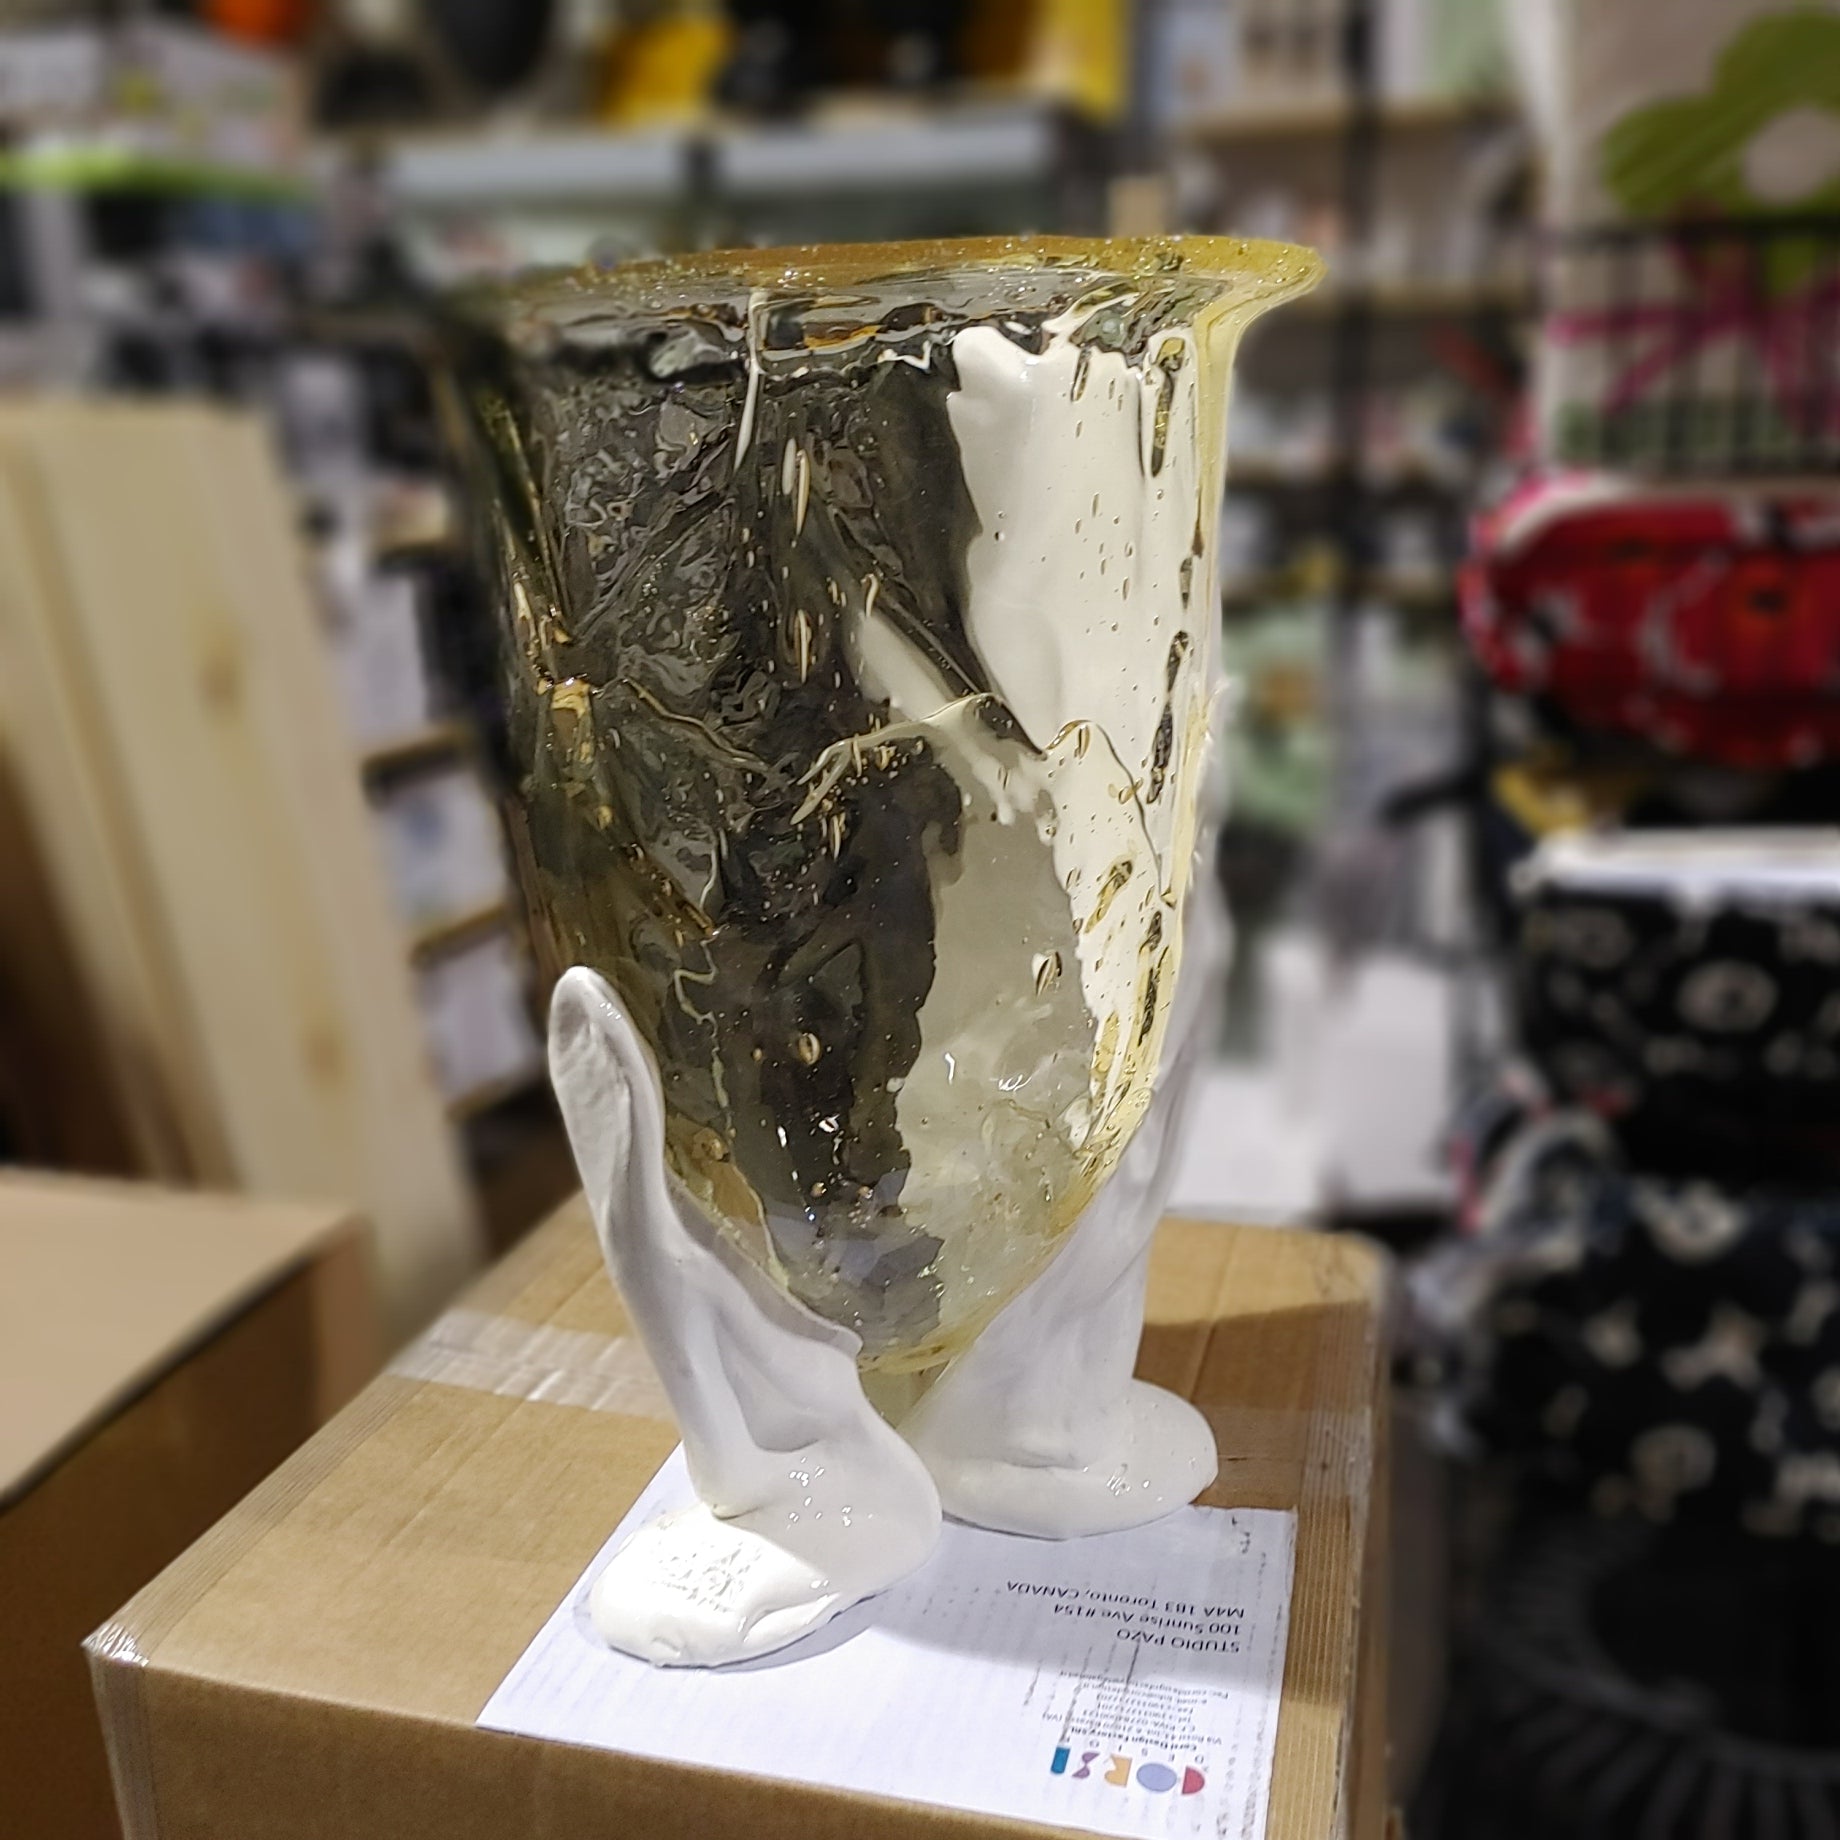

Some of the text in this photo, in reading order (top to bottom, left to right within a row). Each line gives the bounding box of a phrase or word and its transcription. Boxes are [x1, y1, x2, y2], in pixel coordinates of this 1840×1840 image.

[1007, 1580, 1080, 1600] CANADA
[1085, 1590, 1158, 1611] Toronto,
[1101, 1610, 1134, 1624] Ave
[1204, 1606, 1244, 1619] M4A
[1139, 1614, 1204, 1634] Sunrise
[1209, 1622, 1239, 1636] 100
[1117, 1628, 1240, 1653] STUDIO PAZO
